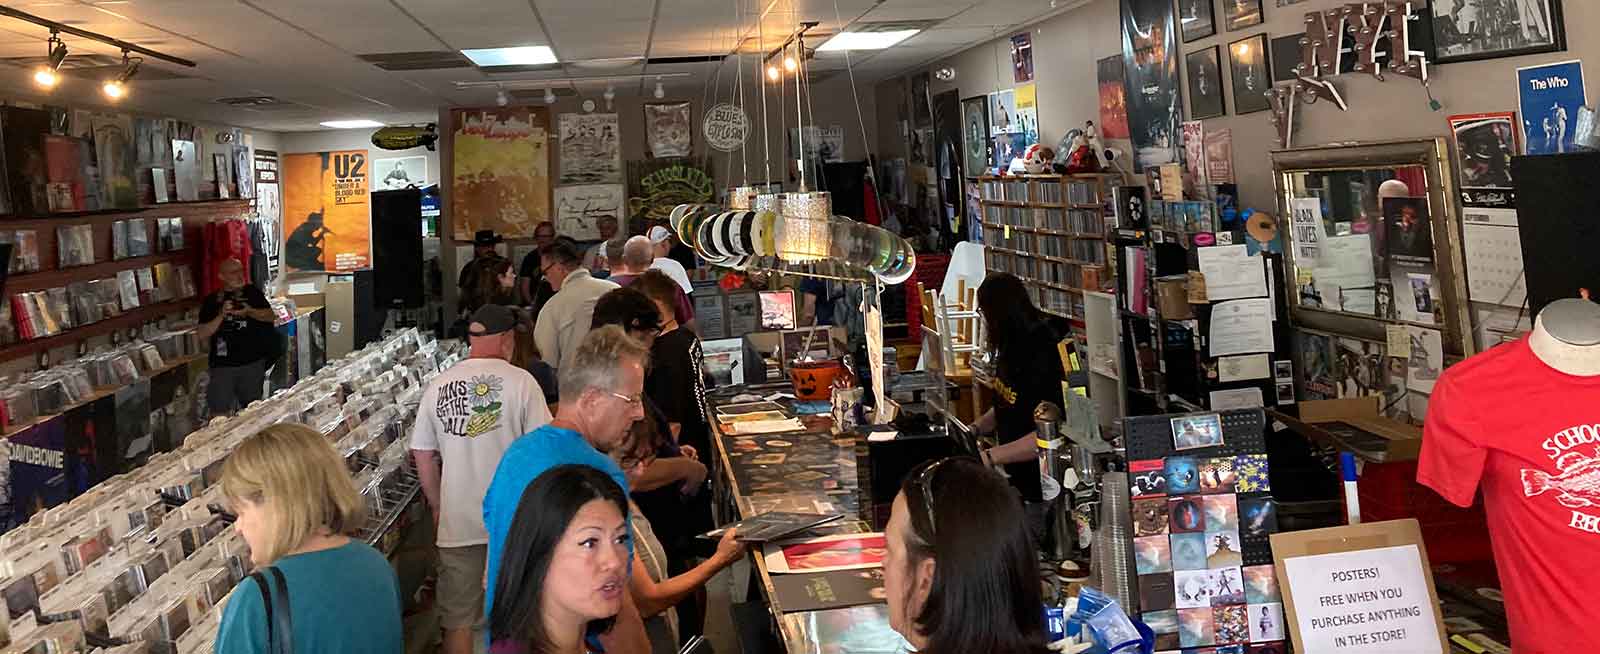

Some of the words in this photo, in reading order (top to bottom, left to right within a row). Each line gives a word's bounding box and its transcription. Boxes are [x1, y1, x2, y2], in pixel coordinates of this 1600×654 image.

[1530, 79, 1547, 90] The
[1547, 76, 1569, 88] Who
[334, 153, 365, 178] U2
[1295, 208, 1315, 222] BLACK
[1297, 225, 1318, 243] LIVES
[437, 380, 467, 406] VANS
[450, 397, 470, 416] THE
[1331, 567, 1380, 582] POSTERS!
[1319, 594, 1345, 607] FREE
[1345, 590, 1378, 604] WHEN
[1380, 587, 1403, 599] YOU
[1311, 613, 1366, 630] PURCHASE
[1368, 606, 1421, 623] ANYTHING
[1335, 637, 1347, 648] IN
[1348, 633, 1370, 646] THE
[1371, 628, 1407, 643] STORE!
